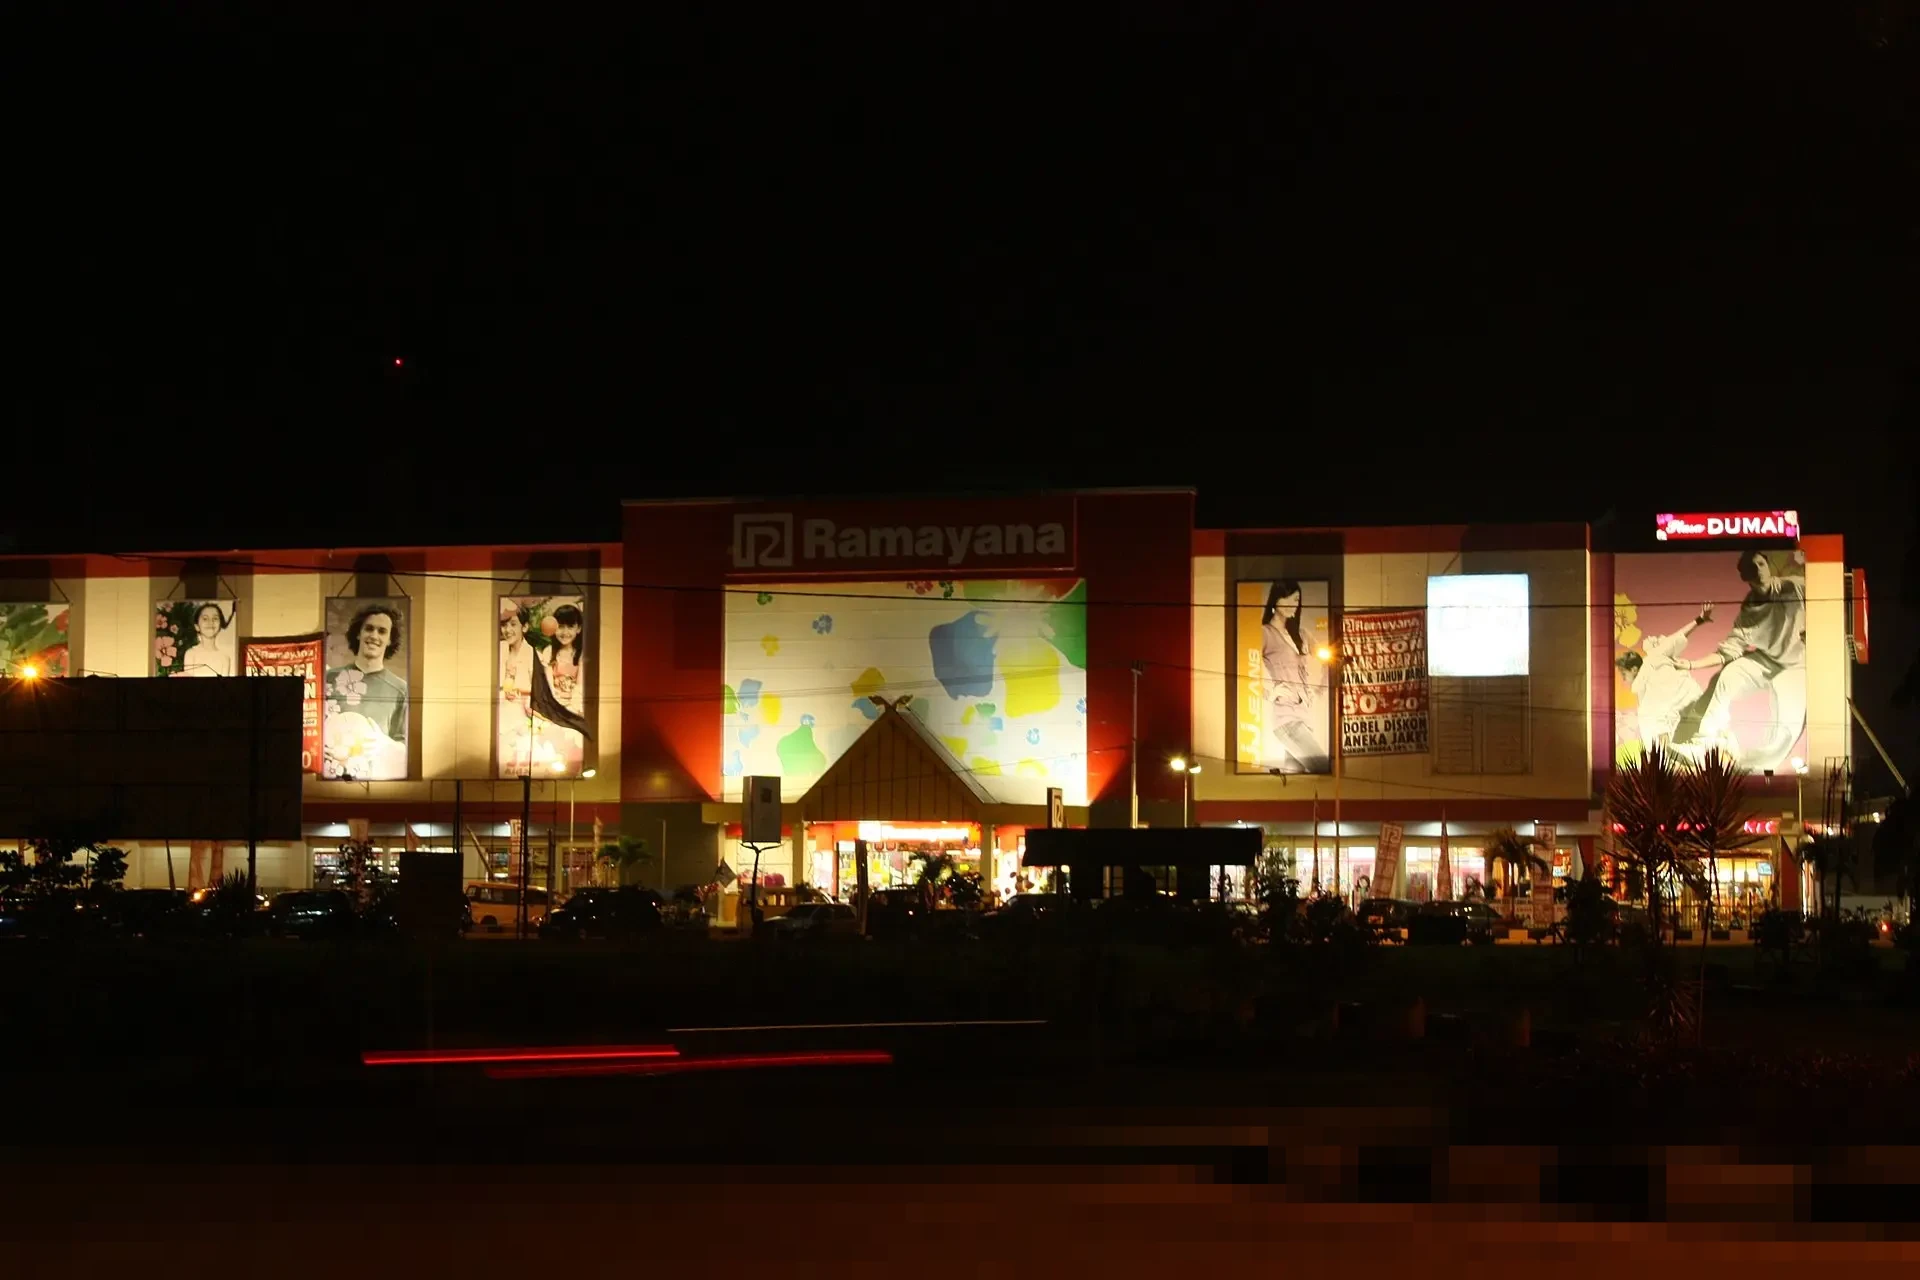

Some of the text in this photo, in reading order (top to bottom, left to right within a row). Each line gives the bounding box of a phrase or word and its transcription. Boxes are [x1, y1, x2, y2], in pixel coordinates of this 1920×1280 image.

[1707, 517, 1784, 535] DUMAI
[803, 519, 1065, 565] Ramayana
[1376, 669, 1403, 682] TAHUN
[1344, 717, 1427, 734] DOBEL DISKON
[1344, 733, 1387, 746] ANEKA
